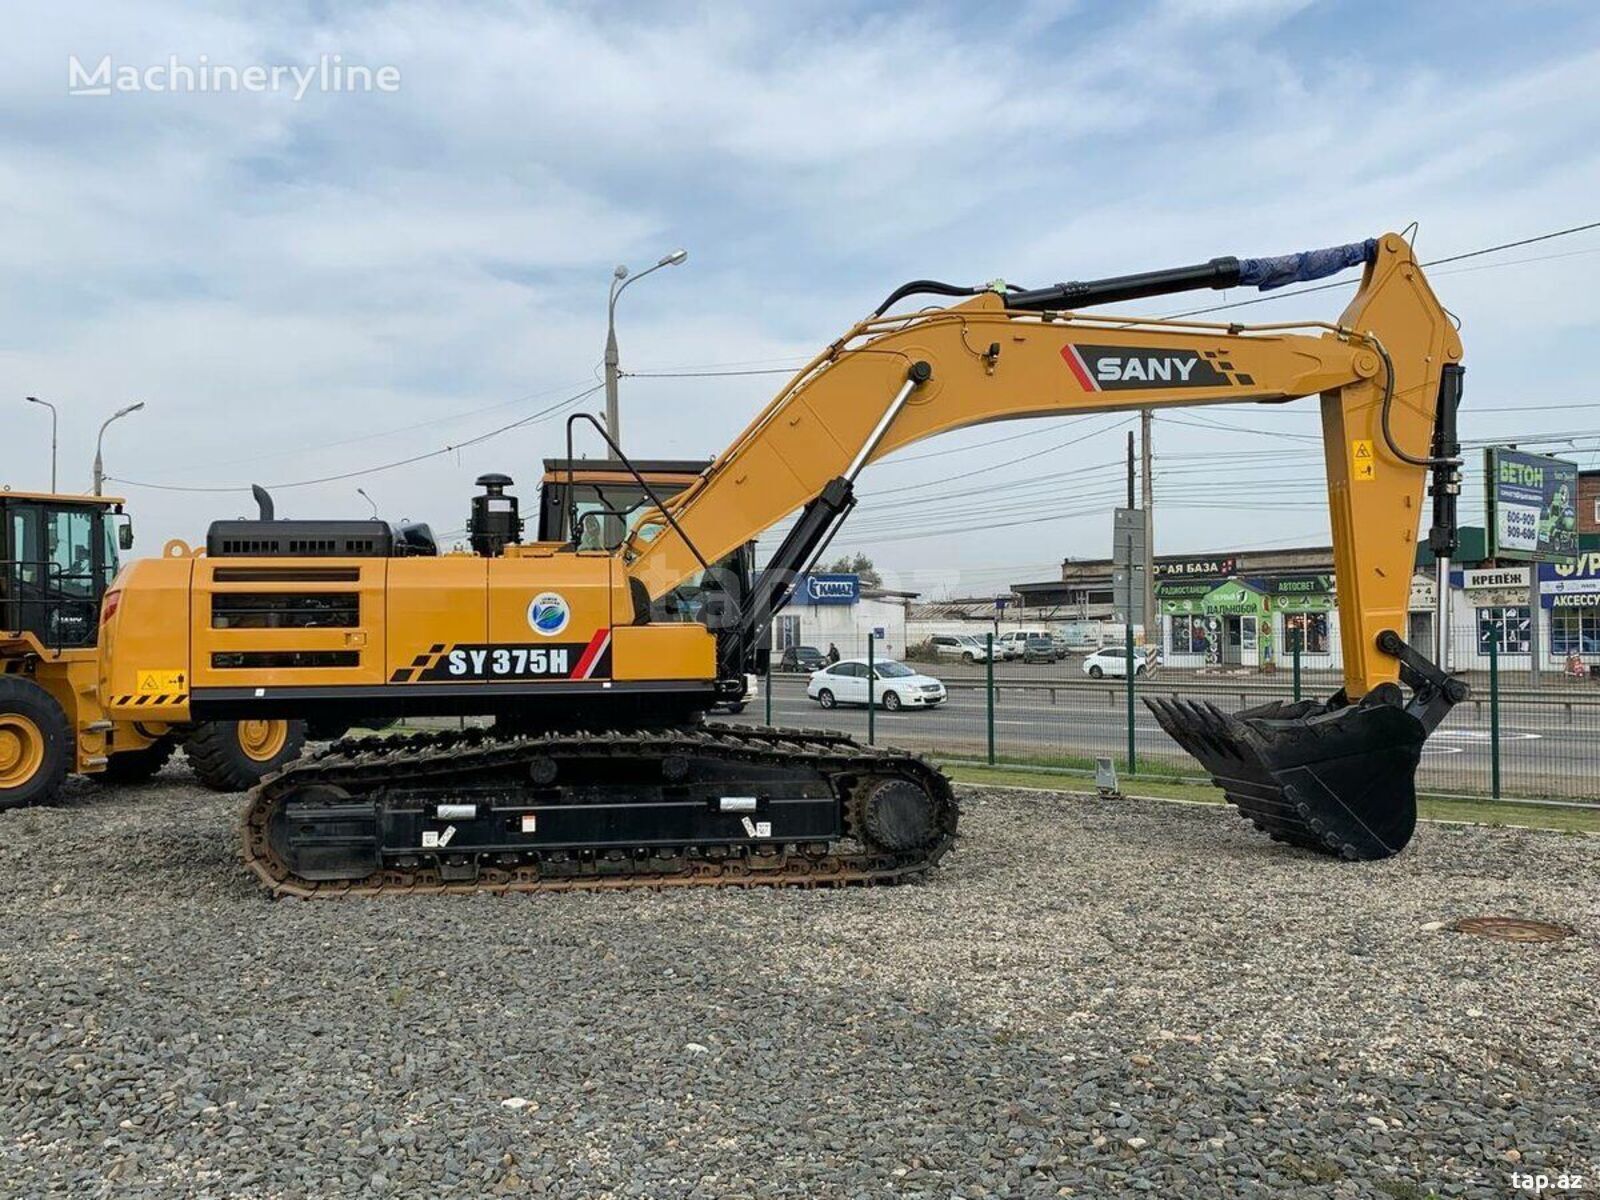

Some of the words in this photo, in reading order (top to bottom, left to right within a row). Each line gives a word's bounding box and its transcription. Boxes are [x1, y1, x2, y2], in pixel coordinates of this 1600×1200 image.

[1097, 357, 1198, 381] SANY
[1500, 460, 1544, 488] БЕТОН
[1186, 562, 1218, 573] БАЗА
[1472, 573, 1522, 585] КРЕПЁЖ
[818, 582, 854, 597] KAMAZ
[1278, 581, 1315, 592] АВТОСВЕТ
[1207, 603, 1258, 615] ДАЛЬНОБОЙ
[448, 649, 488, 675] SY
[492, 649, 568, 675] 375H
